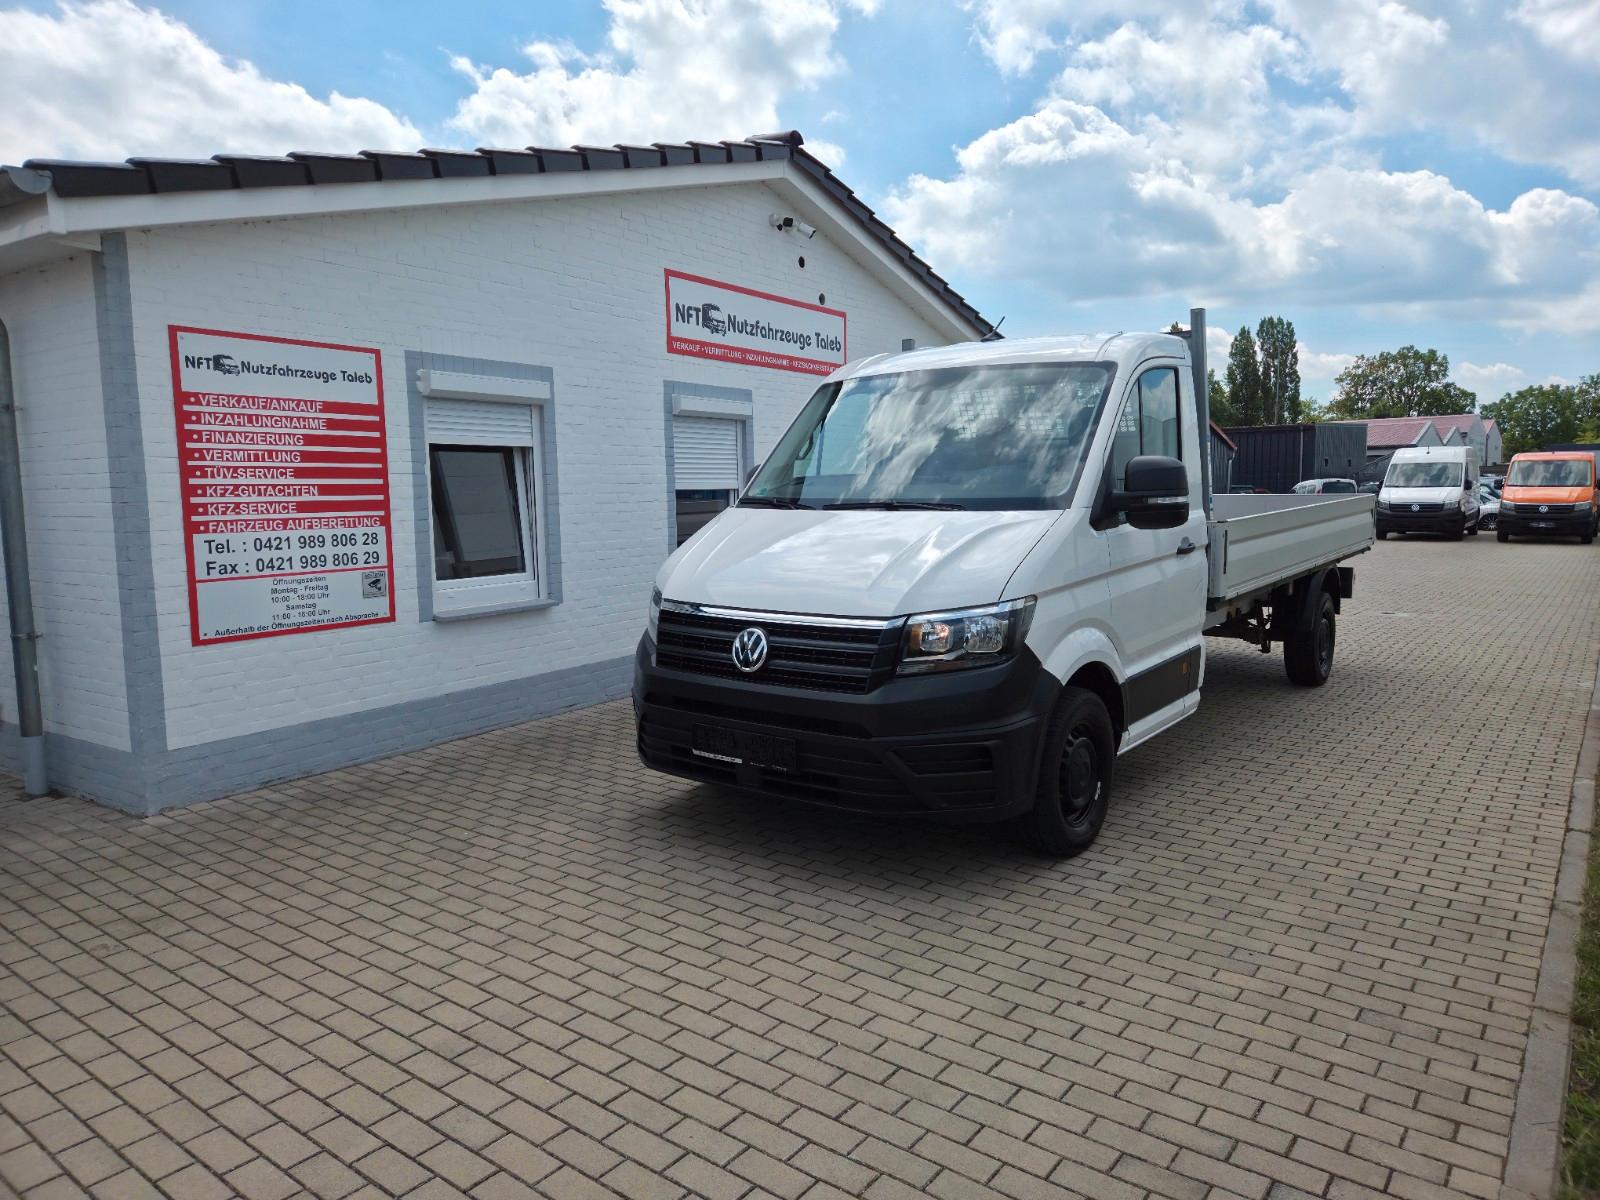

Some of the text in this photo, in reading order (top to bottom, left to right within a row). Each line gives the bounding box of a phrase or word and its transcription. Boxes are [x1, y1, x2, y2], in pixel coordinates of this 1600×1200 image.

[675, 302, 842, 352] NFT Nutzfahrzeuge Taleb
[672, 341, 701, 353] VERKAUF
[184, 355, 373, 384] NFT Nutzfahrzeuge Taleb
[198, 394, 324, 413] VERKAUF/ANKAUF
[200, 413, 328, 430] INZAHLUNGNAHME
[202, 431, 304, 446] FINANZIERUNG
[203, 449, 301, 463] VERMITTLUNG
[205, 465, 295, 479] TÜV-SERVICE
[206, 485, 319, 498] KFZ-GUTACHTEN
[207, 503, 297, 516] KFZ-SERVICE
[208, 517, 380, 534] FAHRZEUG AUFBEREITUNG
[204, 539, 236, 554] Tel.
[253, 536, 291, 552] 0421
[298, 534, 326, 549] 989
[331, 533, 358, 547] 806
[362, 532, 379, 546] 28
[206, 560, 239, 576] Fax
[255, 556, 294, 573] 0421
[300, 554, 327, 569] 989
[332, 553, 359, 567] 806
[363, 551, 380, 564] 29
[271, 587, 298, 595] Montag
[304, 584, 329, 592] Freitag
[285, 602, 317, 611] Samstag
[214, 612, 379, 637] Außerhalb der Öffnungszeiten nach Absprache
